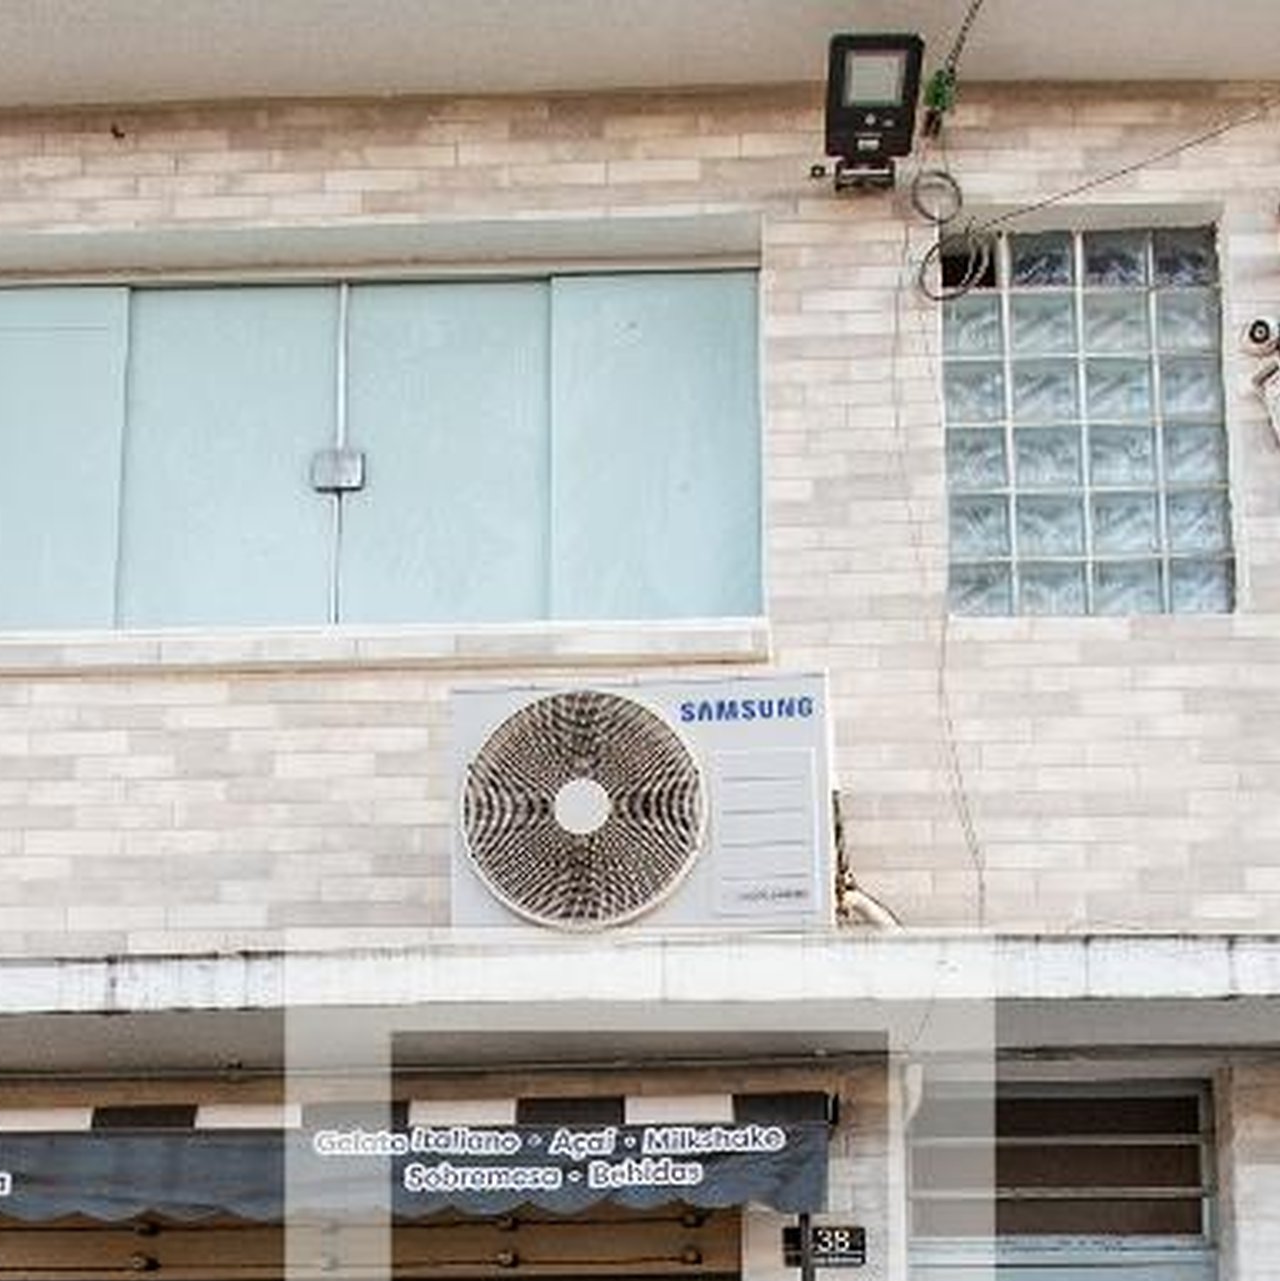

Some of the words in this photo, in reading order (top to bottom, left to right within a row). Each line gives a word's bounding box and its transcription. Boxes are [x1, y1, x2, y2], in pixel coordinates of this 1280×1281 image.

[680, 697, 814, 723] SAMSUNG
[315, 1130, 408, 1154] Gelato
[411, 1127, 521, 1154] Italiano
[642, 1126, 786, 1153] Milkshake
[405, 1162, 562, 1191] Sobremesa
